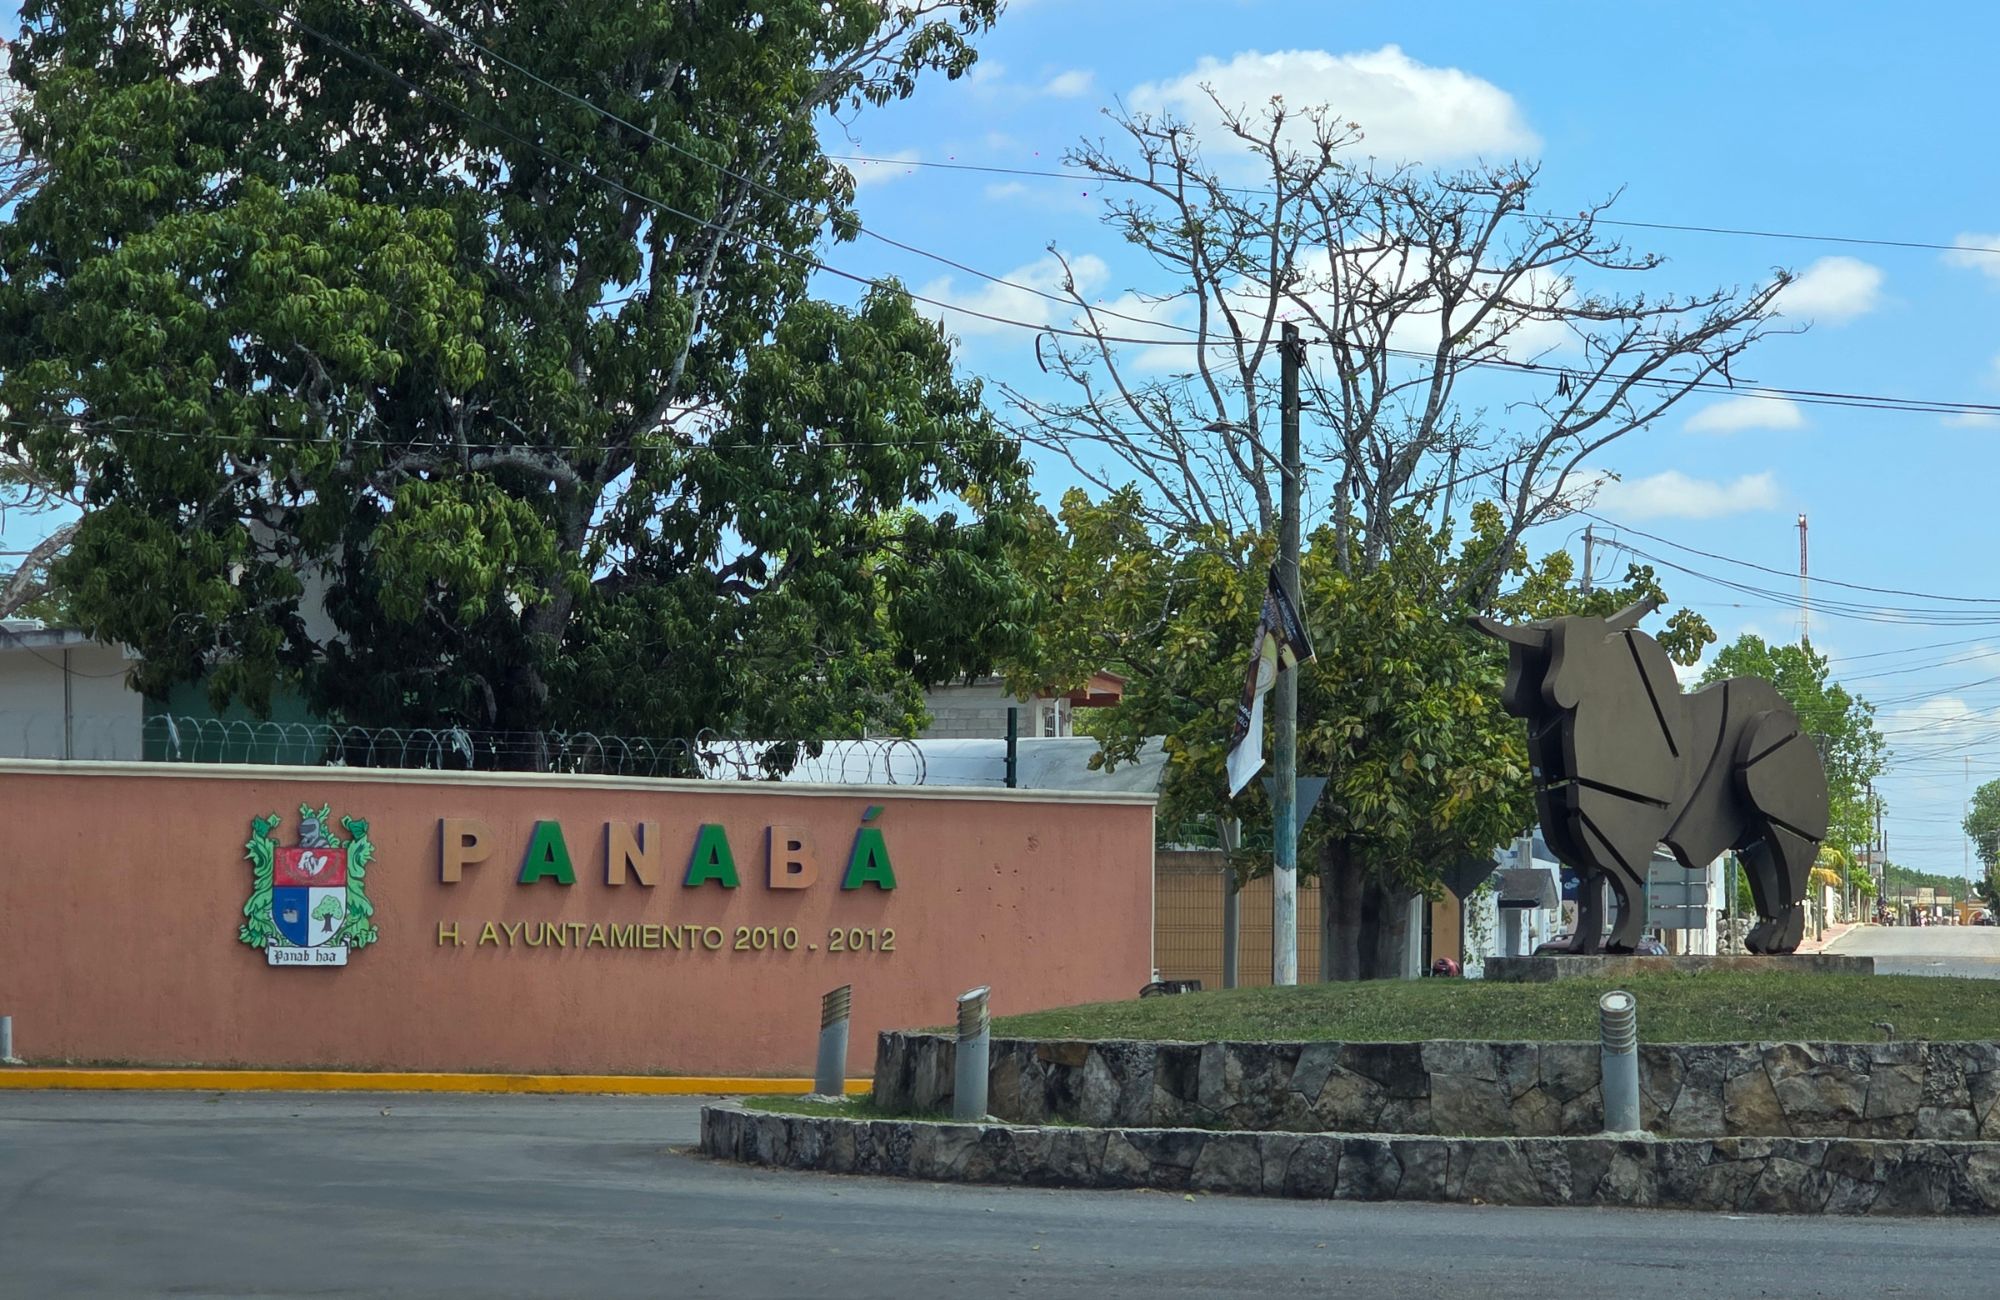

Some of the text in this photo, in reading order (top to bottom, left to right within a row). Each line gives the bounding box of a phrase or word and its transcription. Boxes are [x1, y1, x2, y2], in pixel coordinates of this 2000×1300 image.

[438, 806, 897, 891] PANABÁ
[438, 920, 467, 946] H.
[479, 921, 724, 950] AYUNTAMIENTO
[734, 926, 799, 950] 2010
[828, 927, 897, 951] 2012
[274, 949, 337, 964] Panab haa
